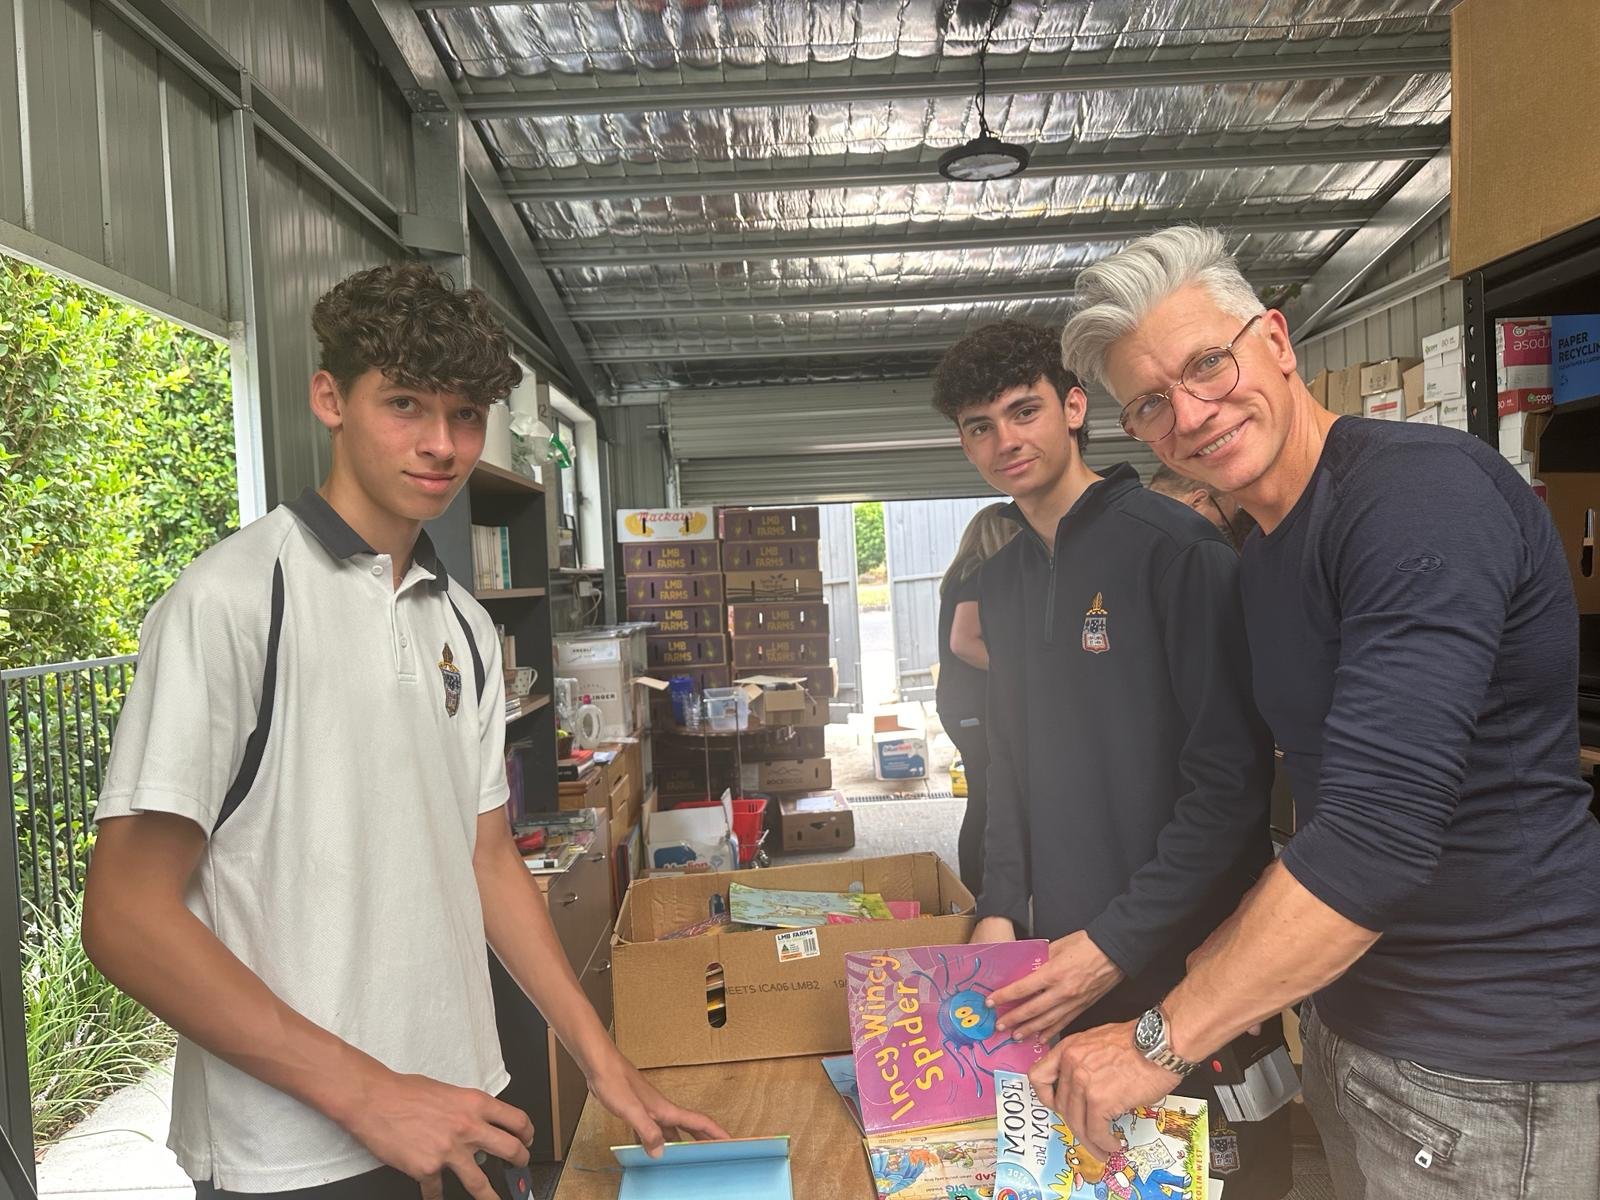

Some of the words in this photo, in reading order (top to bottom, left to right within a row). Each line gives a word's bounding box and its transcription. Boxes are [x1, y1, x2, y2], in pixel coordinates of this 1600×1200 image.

[1558, 332, 1588, 349] PAPER
[761, 515, 780, 526] LMB
[756, 526, 785, 536] FARMS
[661, 548, 680, 558] LMB
[760, 546, 778, 556] LMB
[656, 559, 685, 569] FARMS
[755, 557, 784, 567] FARMS
[664, 580, 682, 590] LMB
[659, 590, 688, 600] FARMS
[664, 610, 683, 620] LMB
[771, 610, 790, 620] LMB
[660, 621, 688, 631] FARMS
[766, 621, 795, 631] FARMS
[668, 641, 687, 651] LMB
[771, 641, 790, 651] LMB
[663, 652, 692, 662] FARMS
[766, 652, 795, 662] FARMS
[777, 933, 791, 941] LMB
[792, 929, 814, 938] FARMS
[726, 985, 757, 995] EETS
[759, 982, 789, 993] ICA06
[791, 980, 820, 991] LMB2
[858, 954, 902, 1041] Wincy
[893, 981, 945, 1091] Spider
[874, 1046, 916, 1122] Incy
[1001, 1079, 1026, 1156] MOOSE
[1032, 1144, 1047, 1166] and
[1195, 1148, 1203, 1171] WEST
